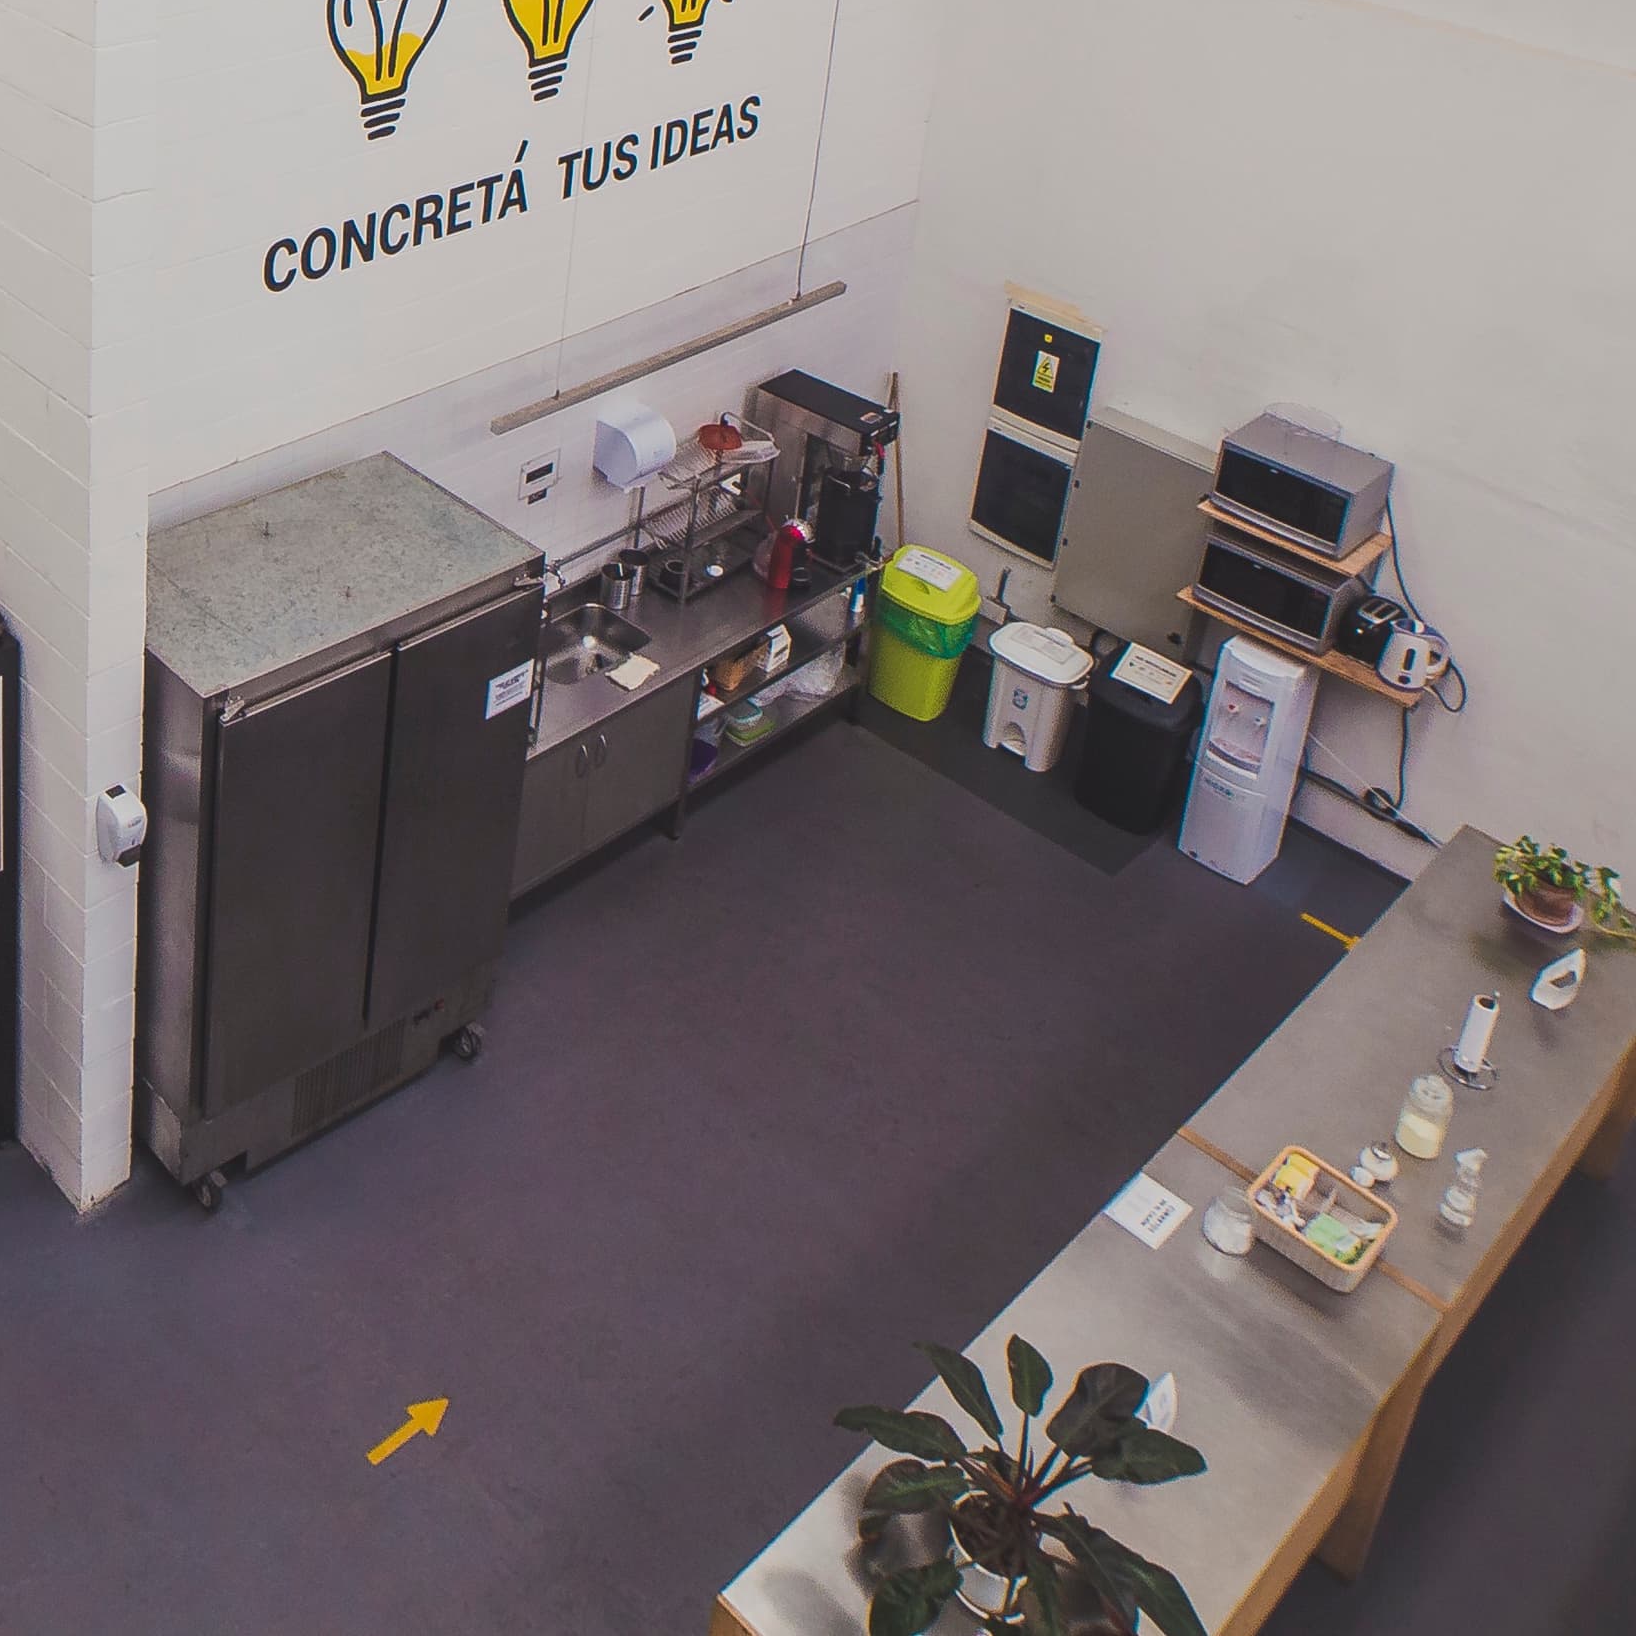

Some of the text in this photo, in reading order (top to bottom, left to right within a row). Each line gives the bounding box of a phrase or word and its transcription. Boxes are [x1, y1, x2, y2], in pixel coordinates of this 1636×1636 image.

[263, 94, 762, 293] CONCRETÁ TUS IDEAS
